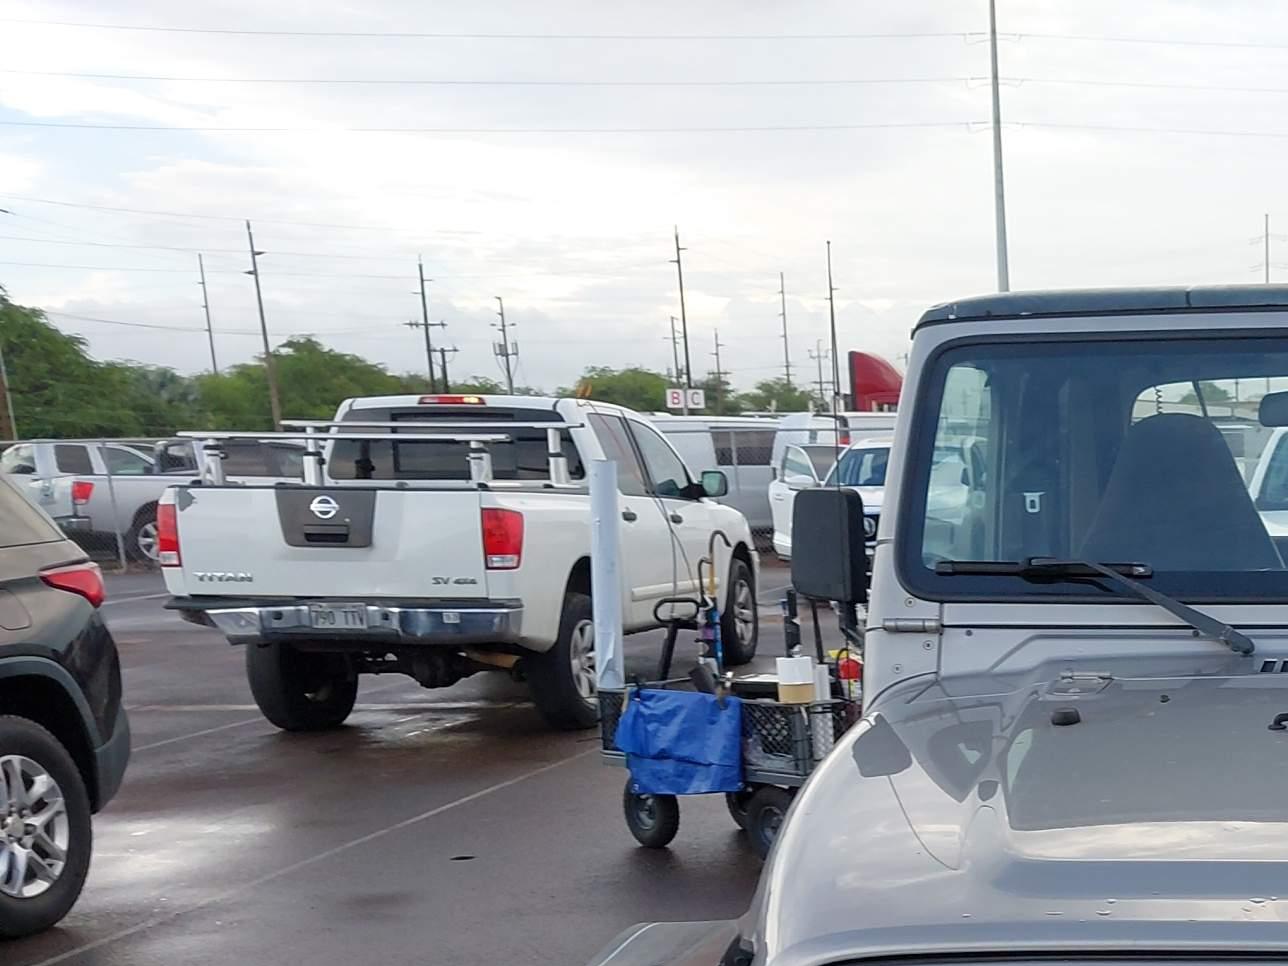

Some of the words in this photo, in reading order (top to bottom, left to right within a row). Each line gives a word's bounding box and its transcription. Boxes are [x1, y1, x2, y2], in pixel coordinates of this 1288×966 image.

[672, 391, 681, 405] B
[691, 391, 701, 406] C
[192, 571, 253, 582] TITAN
[432, 576, 450, 585] SV
